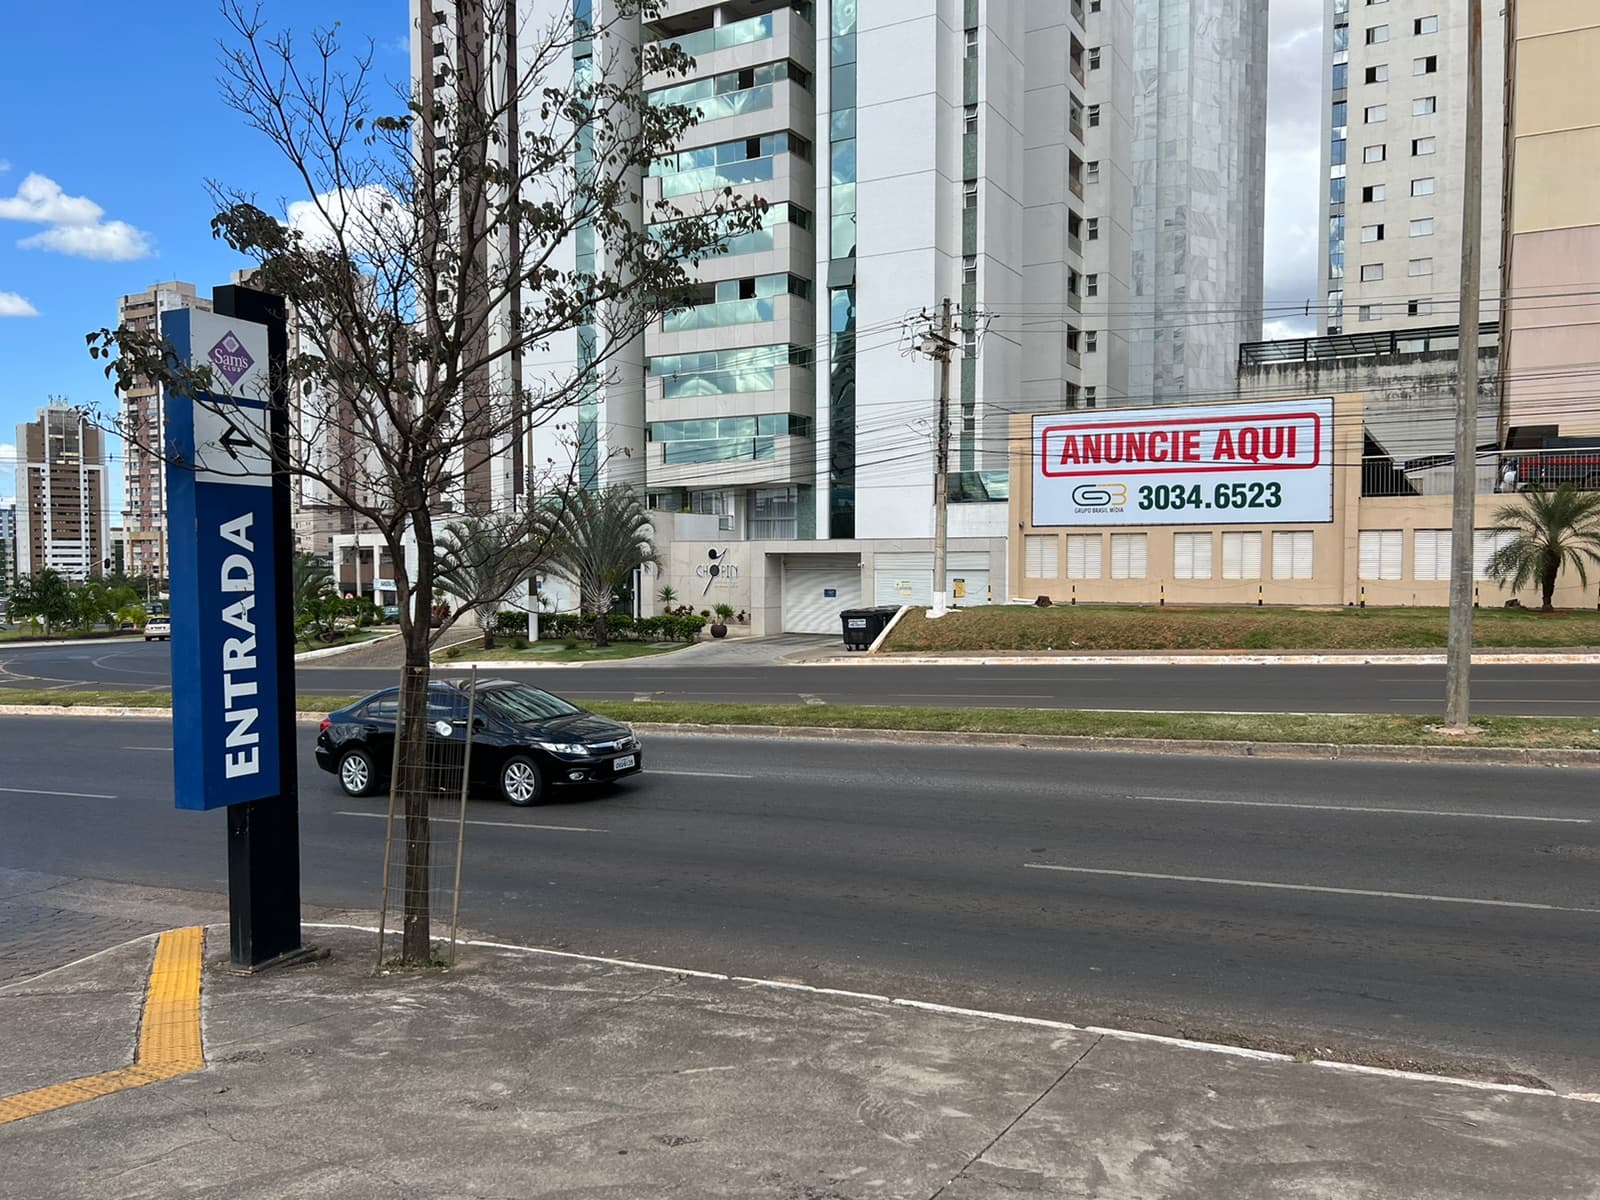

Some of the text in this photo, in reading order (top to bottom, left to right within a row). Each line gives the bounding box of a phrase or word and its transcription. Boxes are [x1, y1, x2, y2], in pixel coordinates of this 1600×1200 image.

[214, 348, 248, 369] Sam's
[1060, 425, 1297, 465] ANUNCIE AQUI
[1138, 482, 1282, 510] 3034.6523
[219, 511, 260, 779] ENTRADA
